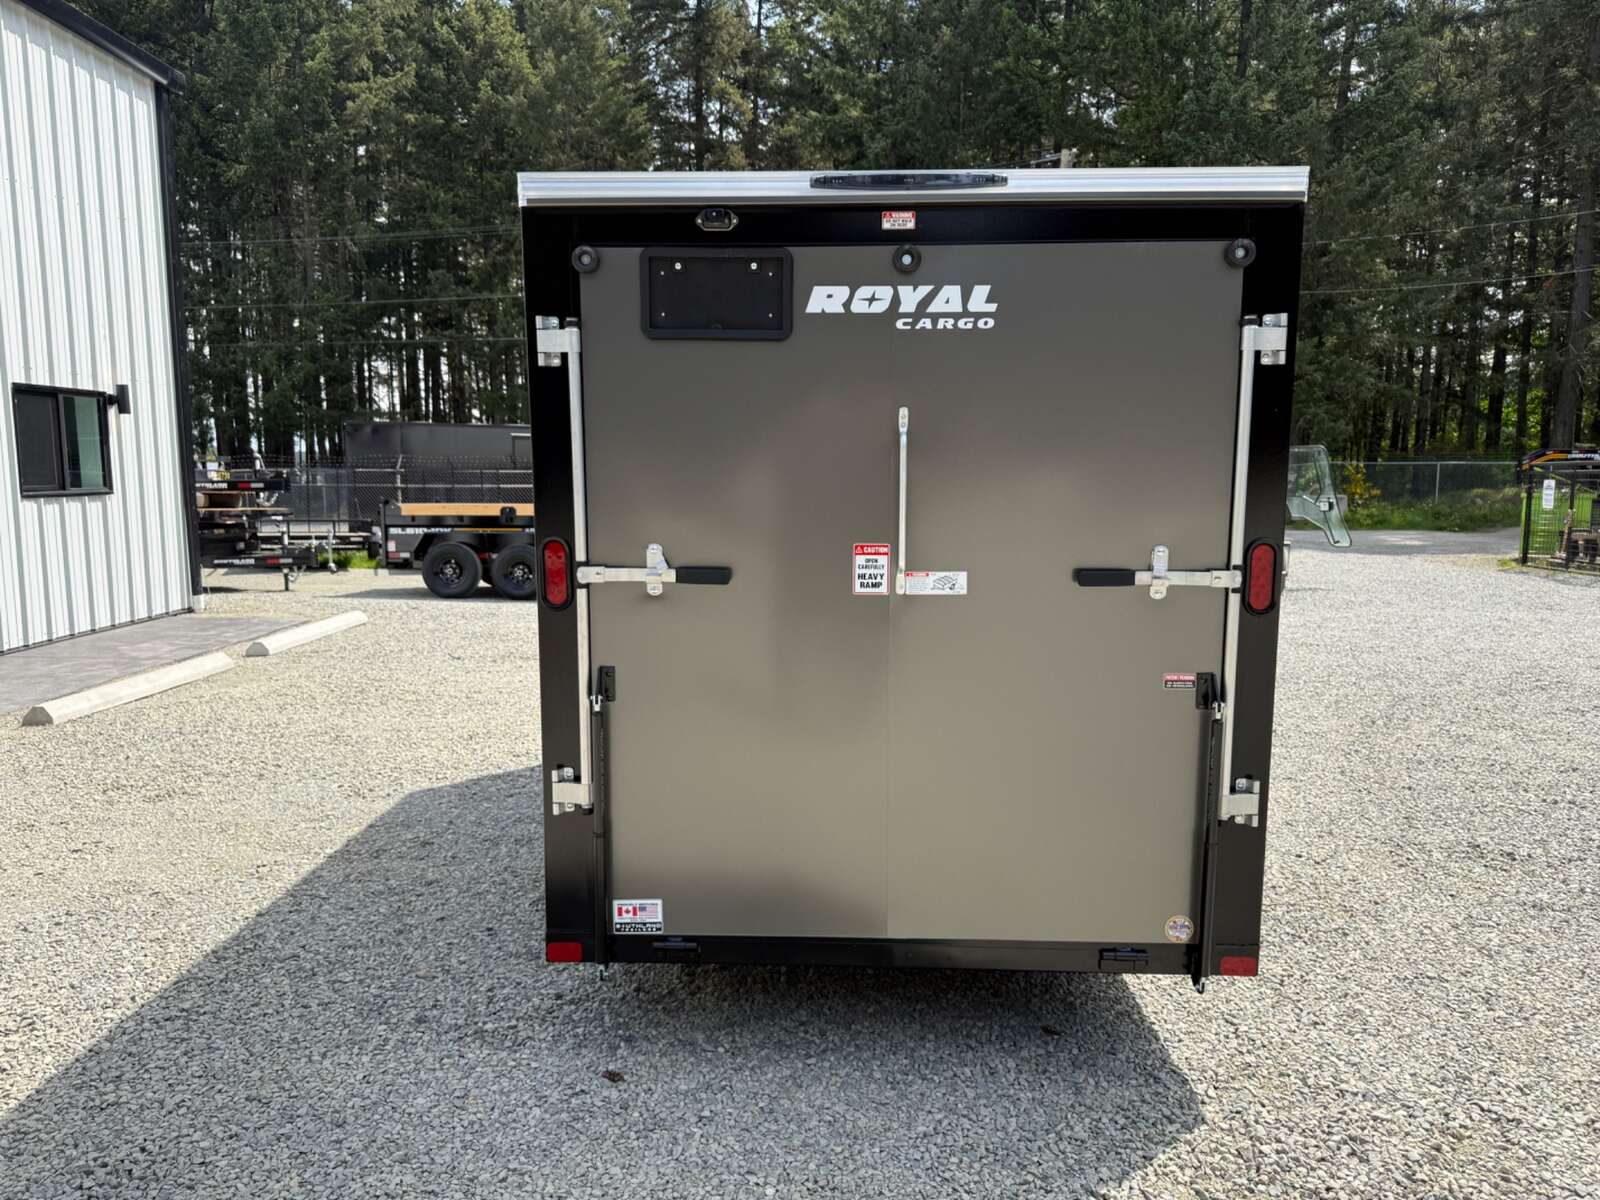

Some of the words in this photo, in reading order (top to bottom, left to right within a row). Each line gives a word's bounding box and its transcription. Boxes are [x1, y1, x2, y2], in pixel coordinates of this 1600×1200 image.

[805, 284, 999, 314] ROYAL
[895, 317, 995, 330] CARGO
[857, 572, 885, 580] HEAVY
[859, 581, 883, 589] RAMP
